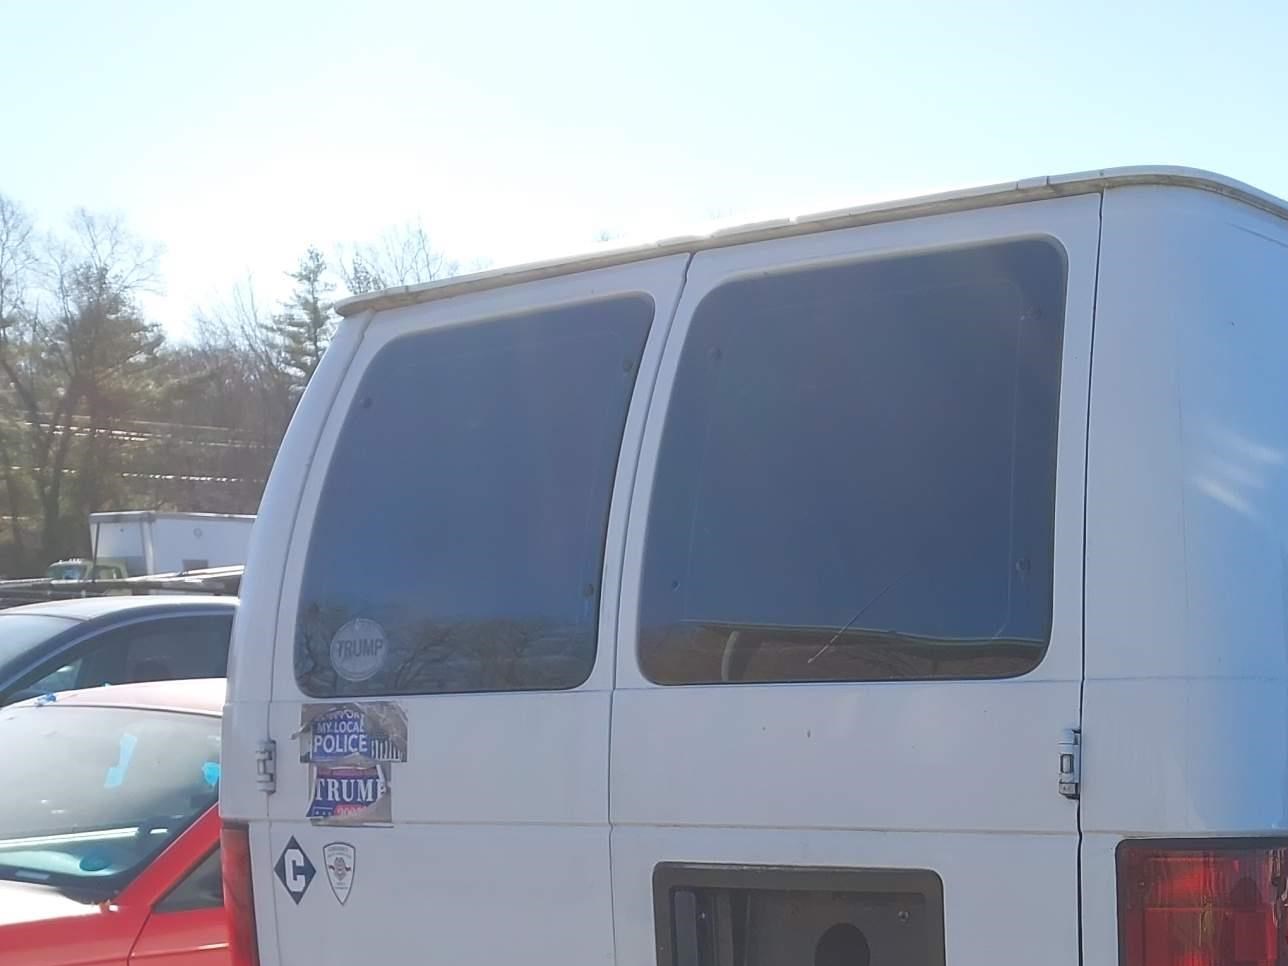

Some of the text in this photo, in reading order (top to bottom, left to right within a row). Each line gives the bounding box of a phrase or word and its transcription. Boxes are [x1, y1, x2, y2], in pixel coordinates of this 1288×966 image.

[336, 638, 384, 658] TRUMP
[334, 721, 365, 733] LOCAL
[314, 734, 369, 753] POLICE
[284, 848, 307, 892] C
